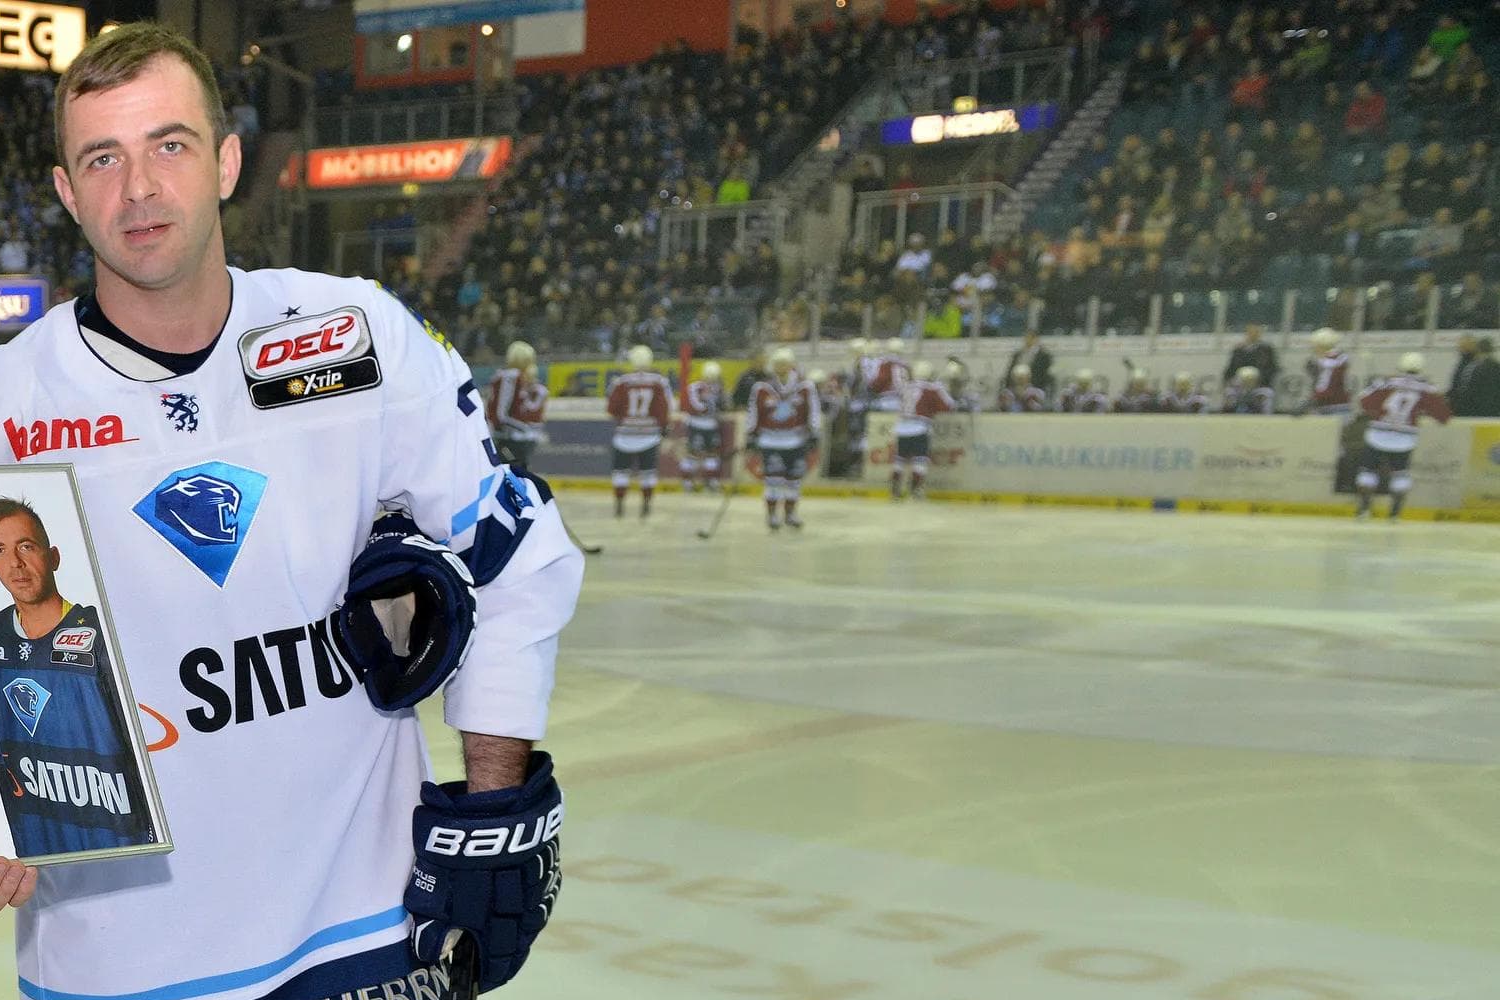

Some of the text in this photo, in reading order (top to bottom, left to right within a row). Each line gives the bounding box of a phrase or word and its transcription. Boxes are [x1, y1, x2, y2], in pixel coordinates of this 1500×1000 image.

[3, 414, 132, 462] hama
[19, 756, 132, 815] SATURN
[424, 803, 564, 857] BAUE
